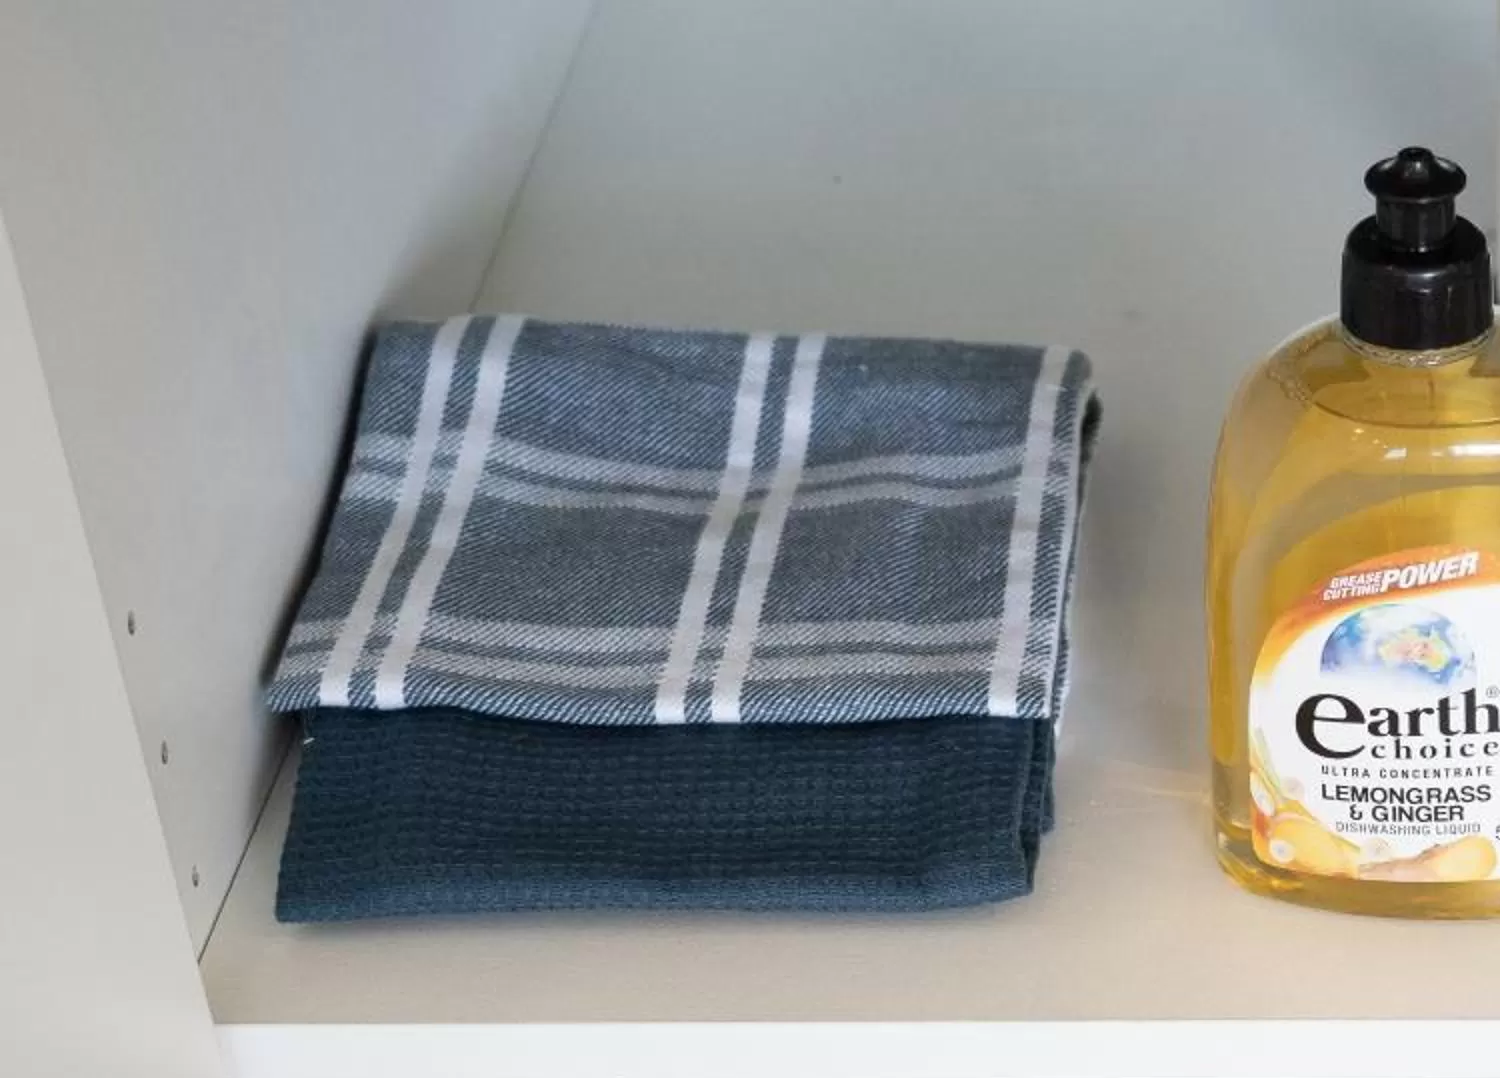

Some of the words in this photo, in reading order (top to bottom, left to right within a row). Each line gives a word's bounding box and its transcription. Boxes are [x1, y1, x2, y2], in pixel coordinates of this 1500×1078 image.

[1330, 571, 1383, 588] GREASE
[1380, 551, 1479, 592] POWER
[1371, 737, 1500, 761] choice
[1321, 765, 1371, 779] ULTRA
[1379, 765, 1494, 779] CONCENTRATE
[1321, 783, 1492, 805] LEMONGRASS
[1349, 805, 1363, 821] &
[1371, 804, 1465, 823] GINGER
[1335, 821, 1432, 836] DISHWASHING
[1435, 822, 1481, 835] LIQUID
